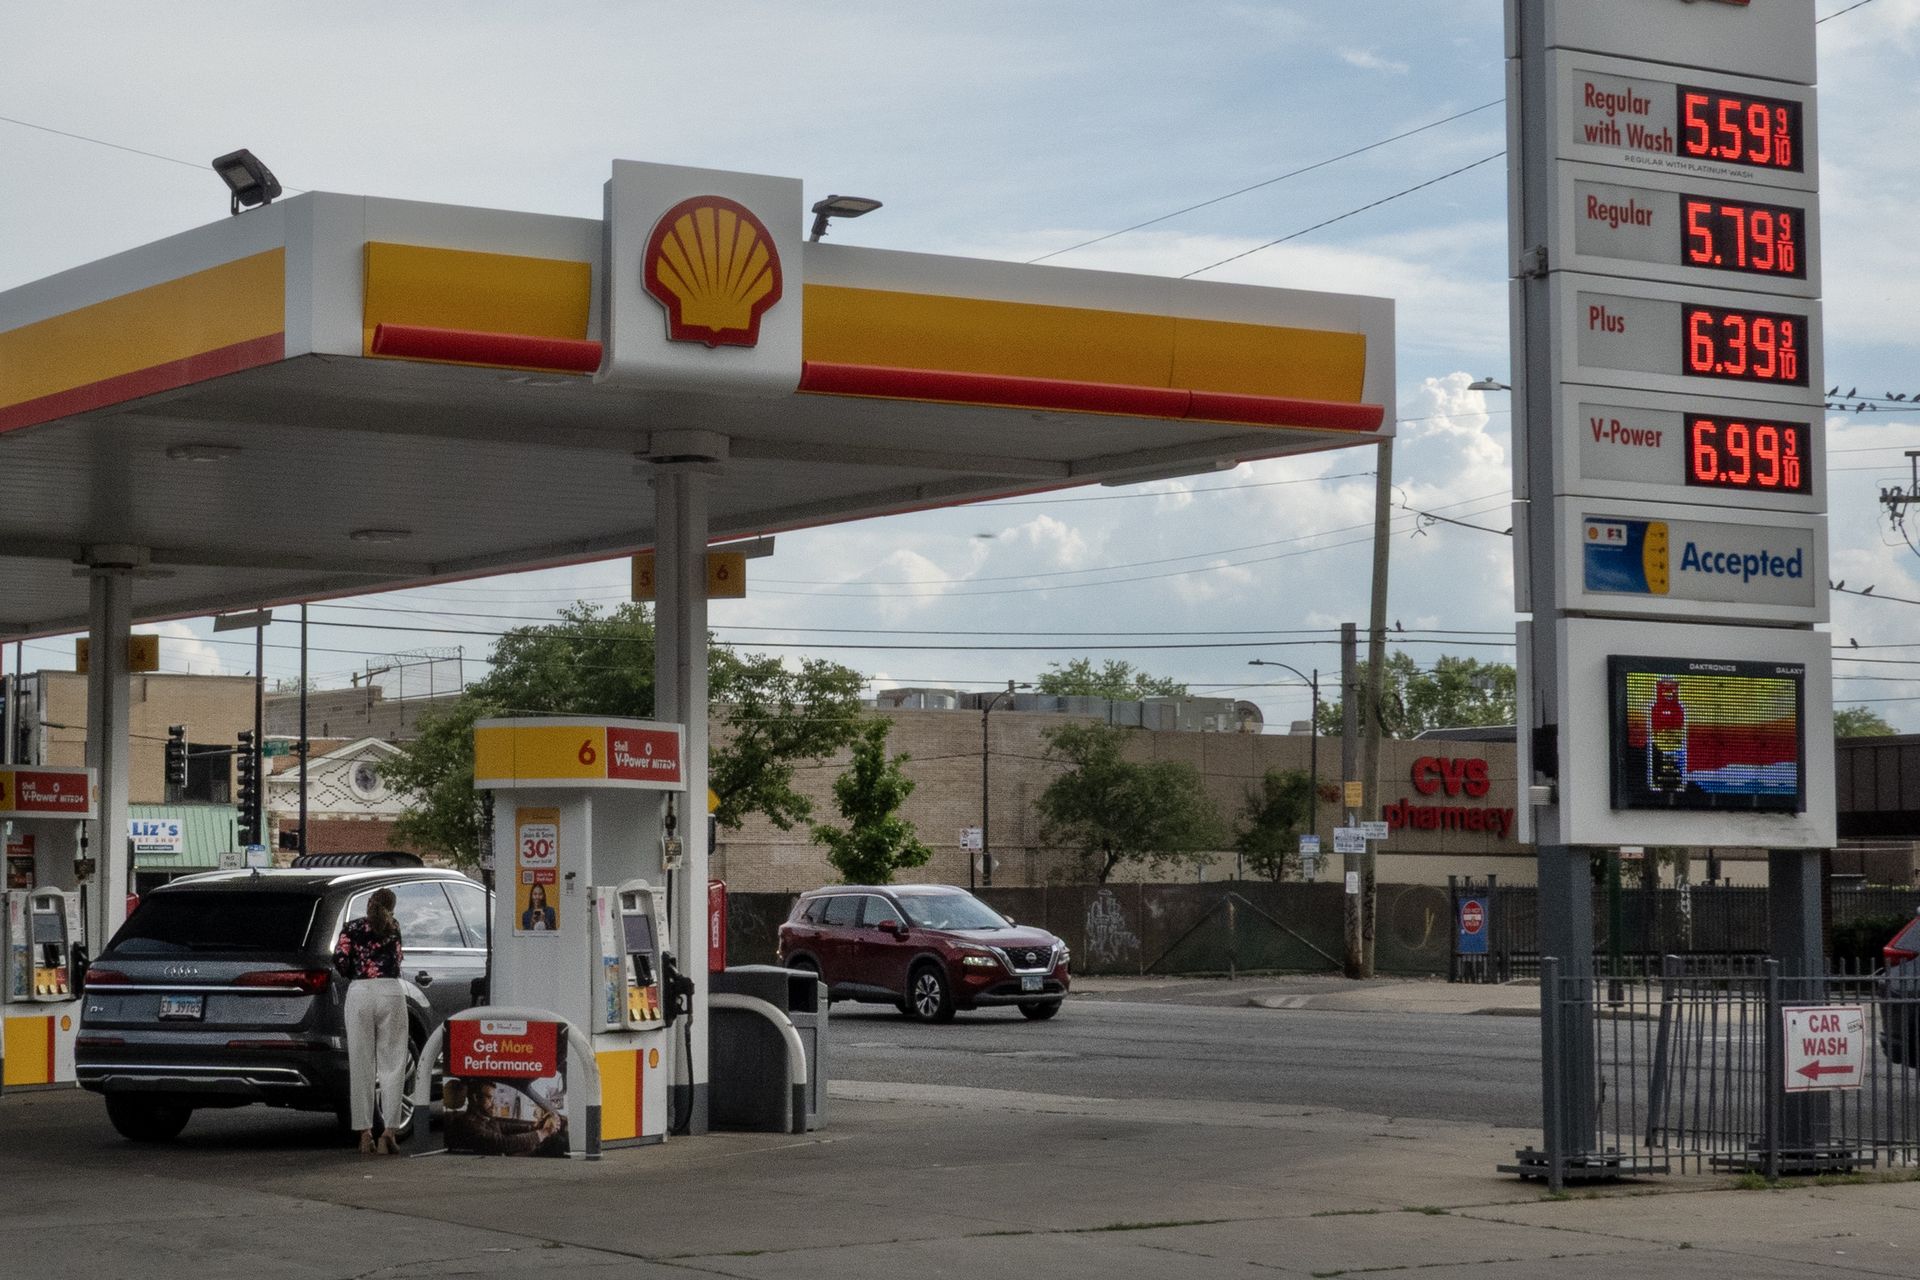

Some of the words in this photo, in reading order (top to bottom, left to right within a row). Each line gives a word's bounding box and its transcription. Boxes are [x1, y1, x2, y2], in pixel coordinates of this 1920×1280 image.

[1584, 82, 1651, 118] Regular
[1584, 120, 1621, 147] with
[1626, 124, 1673, 154] Wash
[1685, 92, 1771, 164] 5.59
[1624, 154, 1664, 167] REGULAR
[1665, 160, 1687, 169] WITH
[1687, 163, 1728, 175] PLATINUM
[1729, 169, 1754, 179] WASH
[1587, 194, 1653, 229] Regular
[1687, 201, 1774, 270] 5.79
[1589, 305, 1625, 334] Plus
[1689, 311, 1776, 378] 6.39
[1590, 417, 1663, 448] V-Power
[1693, 420, 1780, 486] 6.99
[717, 564, 729, 580] 6
[1680, 541, 1803, 583] Accepted
[578, 739, 596, 765] 6
[614, 741, 629, 752] Shell
[614, 753, 650, 768] V-Power
[1411, 756, 1490, 798] CVS
[22, 791, 57, 802] V-Power
[132, 821, 178, 836] Liz's
[1383, 797, 1514, 839] pharmacy
[1809, 1014, 1841, 1033] CAR
[473, 1038, 498, 1053] Get
[500, 1040, 534, 1053] More
[1803, 1037, 1848, 1056] WASH
[464, 1055, 542, 1071] Performance
